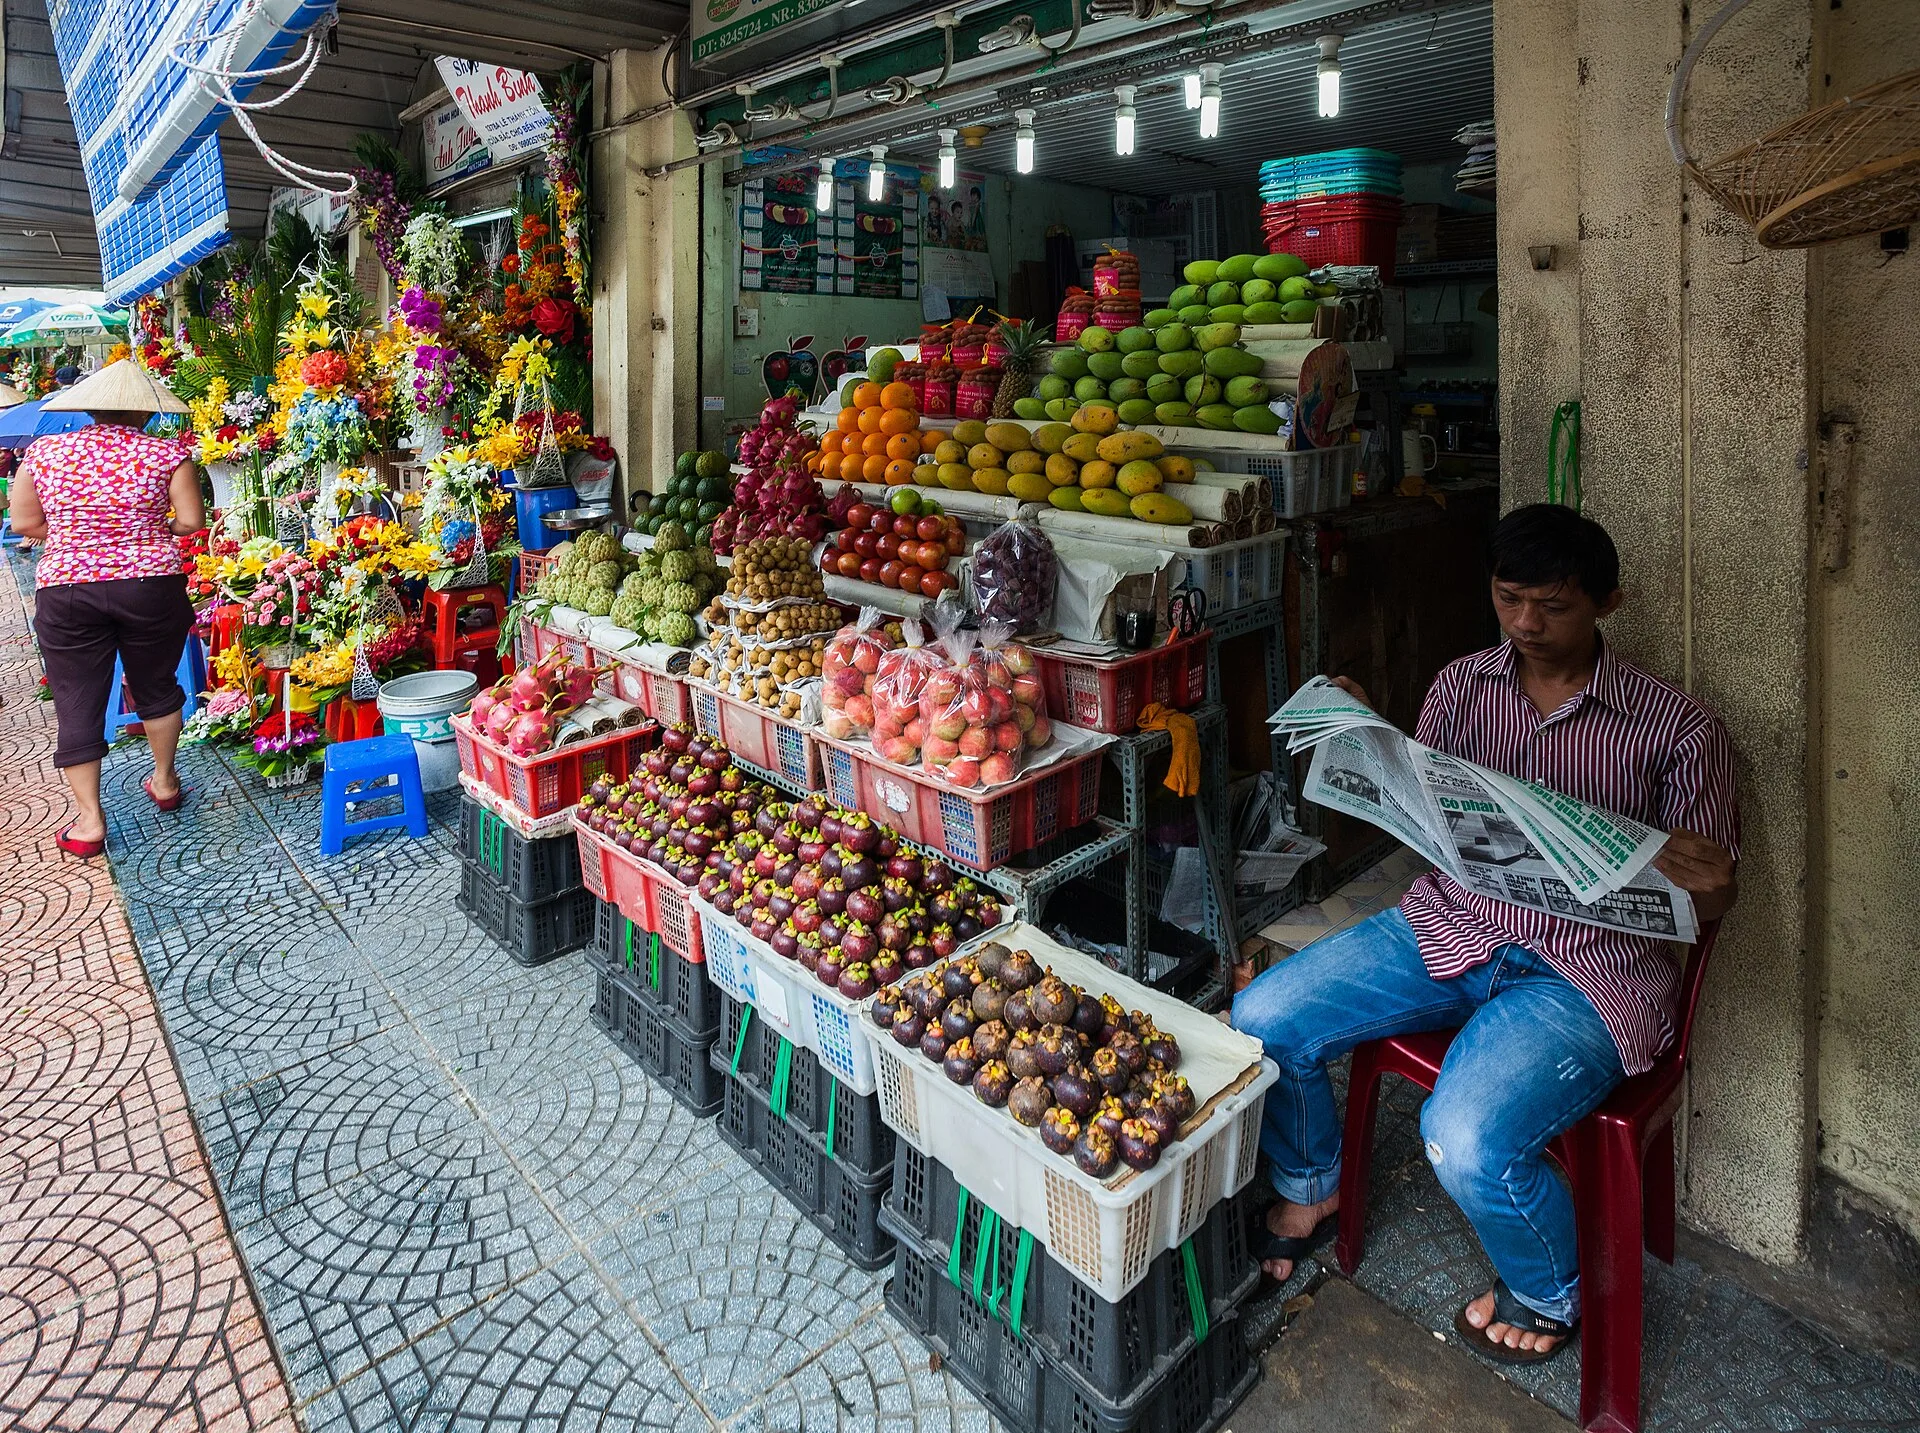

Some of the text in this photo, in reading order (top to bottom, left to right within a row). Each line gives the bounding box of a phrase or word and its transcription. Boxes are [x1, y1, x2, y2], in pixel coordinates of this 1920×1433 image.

[697, 41, 717, 58] ĐT:
[720, 19, 761, 49] 8245724
[771, 9, 795, 26] NR:
[455, 66, 536, 119] Thanh Bình
[522, 119, 536, 133] BẾN
[1554, 798, 1583, 826] tình
[1581, 820, 1630, 864] Những
